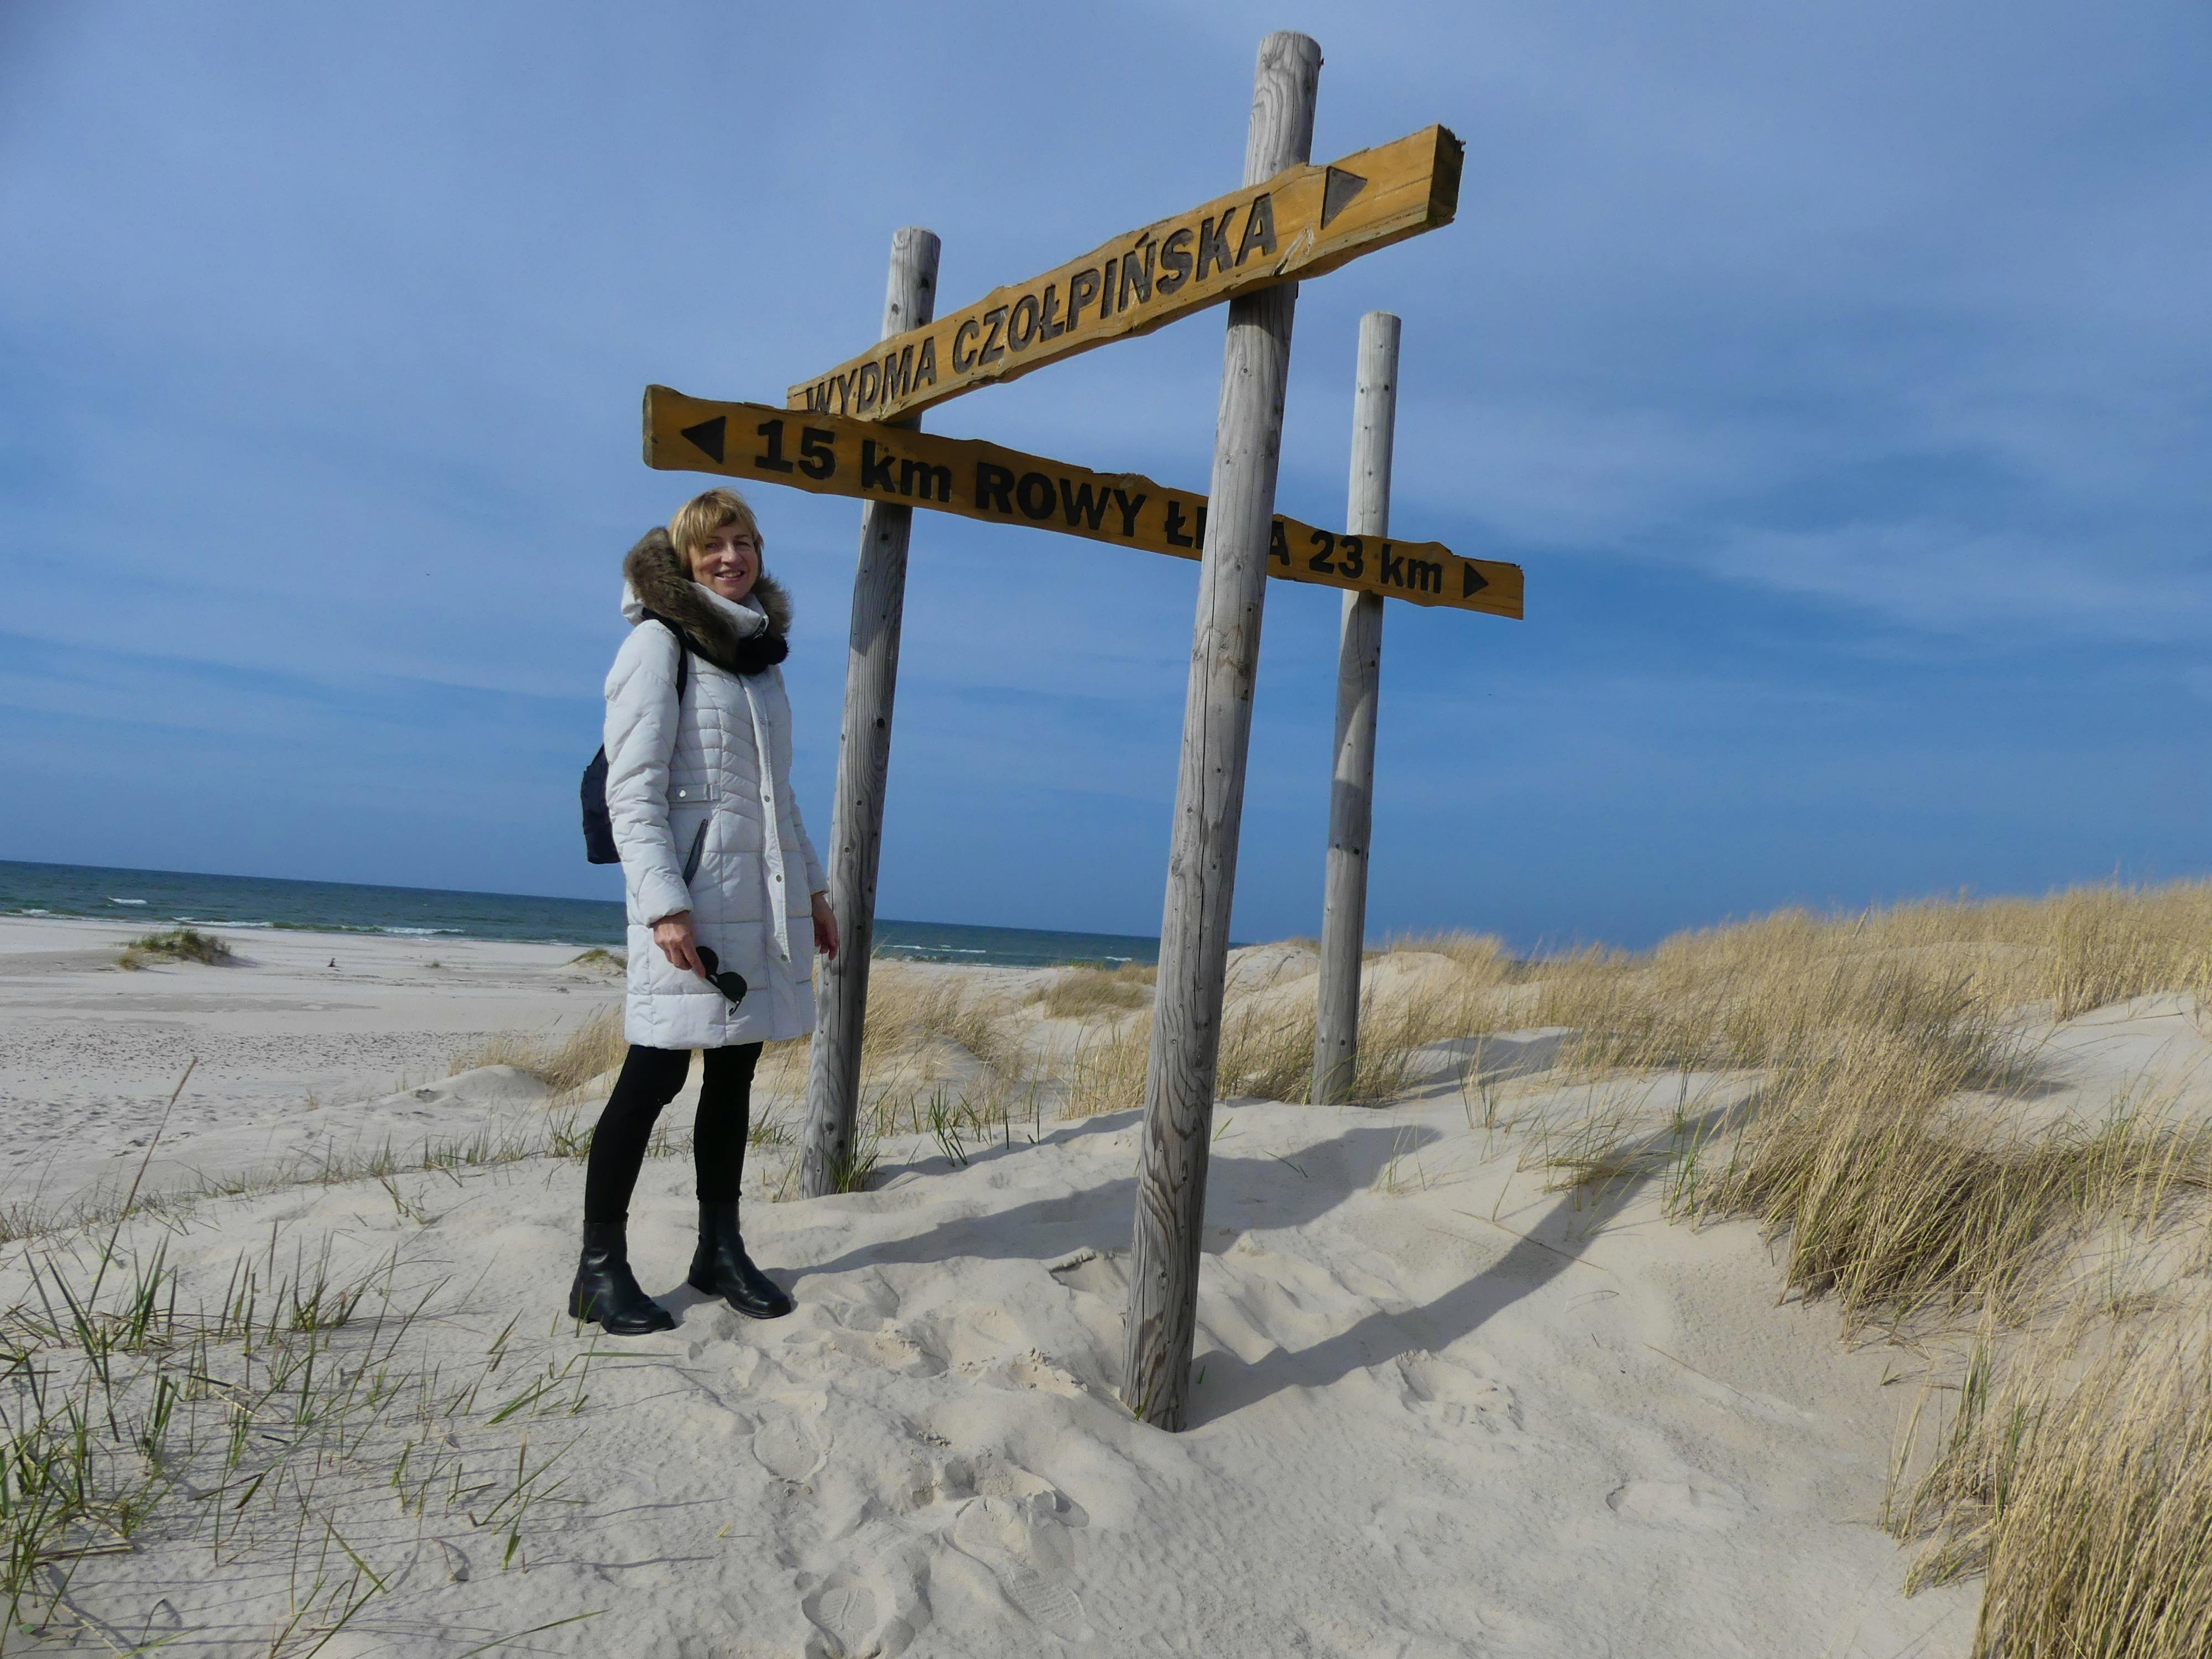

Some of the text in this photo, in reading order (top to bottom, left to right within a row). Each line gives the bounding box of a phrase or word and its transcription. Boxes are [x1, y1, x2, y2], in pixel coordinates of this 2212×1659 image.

[806, 192, 1277, 415] WYDMA CZOŁPIŃSKA
[754, 419, 1442, 594] 15 km ROWY ŁA 23 km
